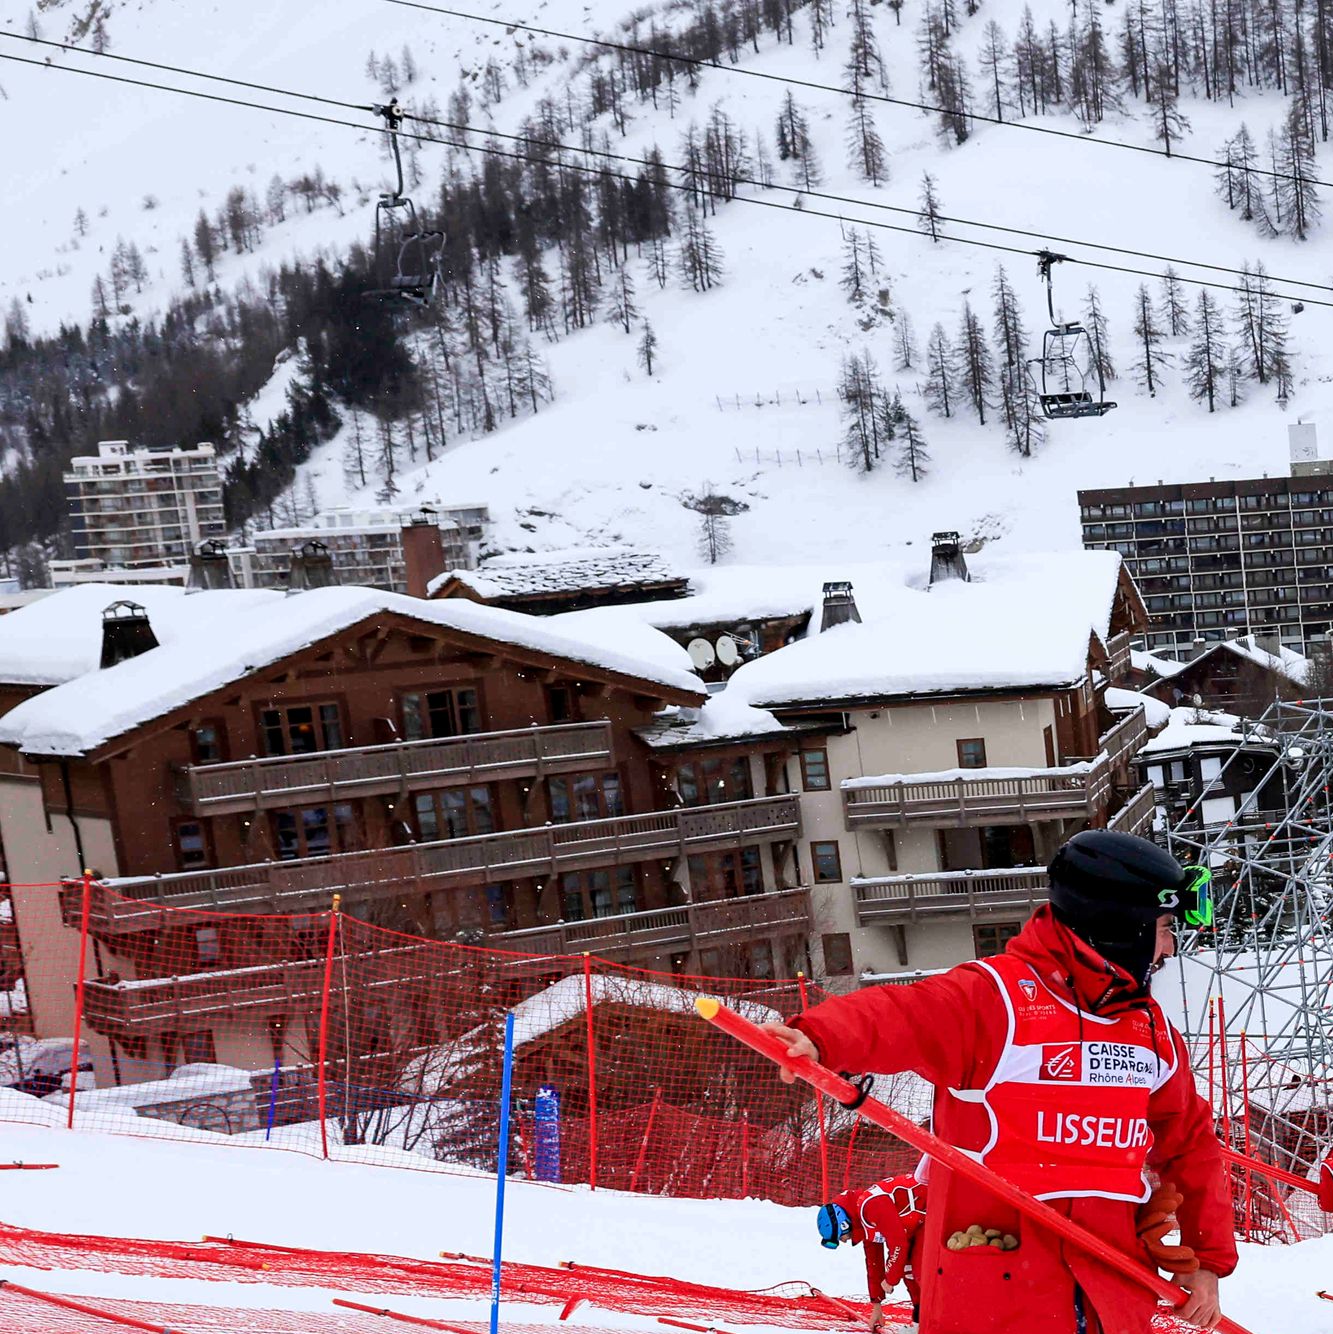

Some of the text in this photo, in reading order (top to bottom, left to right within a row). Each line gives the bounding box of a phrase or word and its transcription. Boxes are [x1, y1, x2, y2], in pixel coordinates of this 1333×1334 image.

[1088, 1044, 1135, 1058] CAISSE
[1090, 1058, 1153, 1074] D'EPARGNE
[1090, 1073, 1146, 1085] Rhône Alpes
